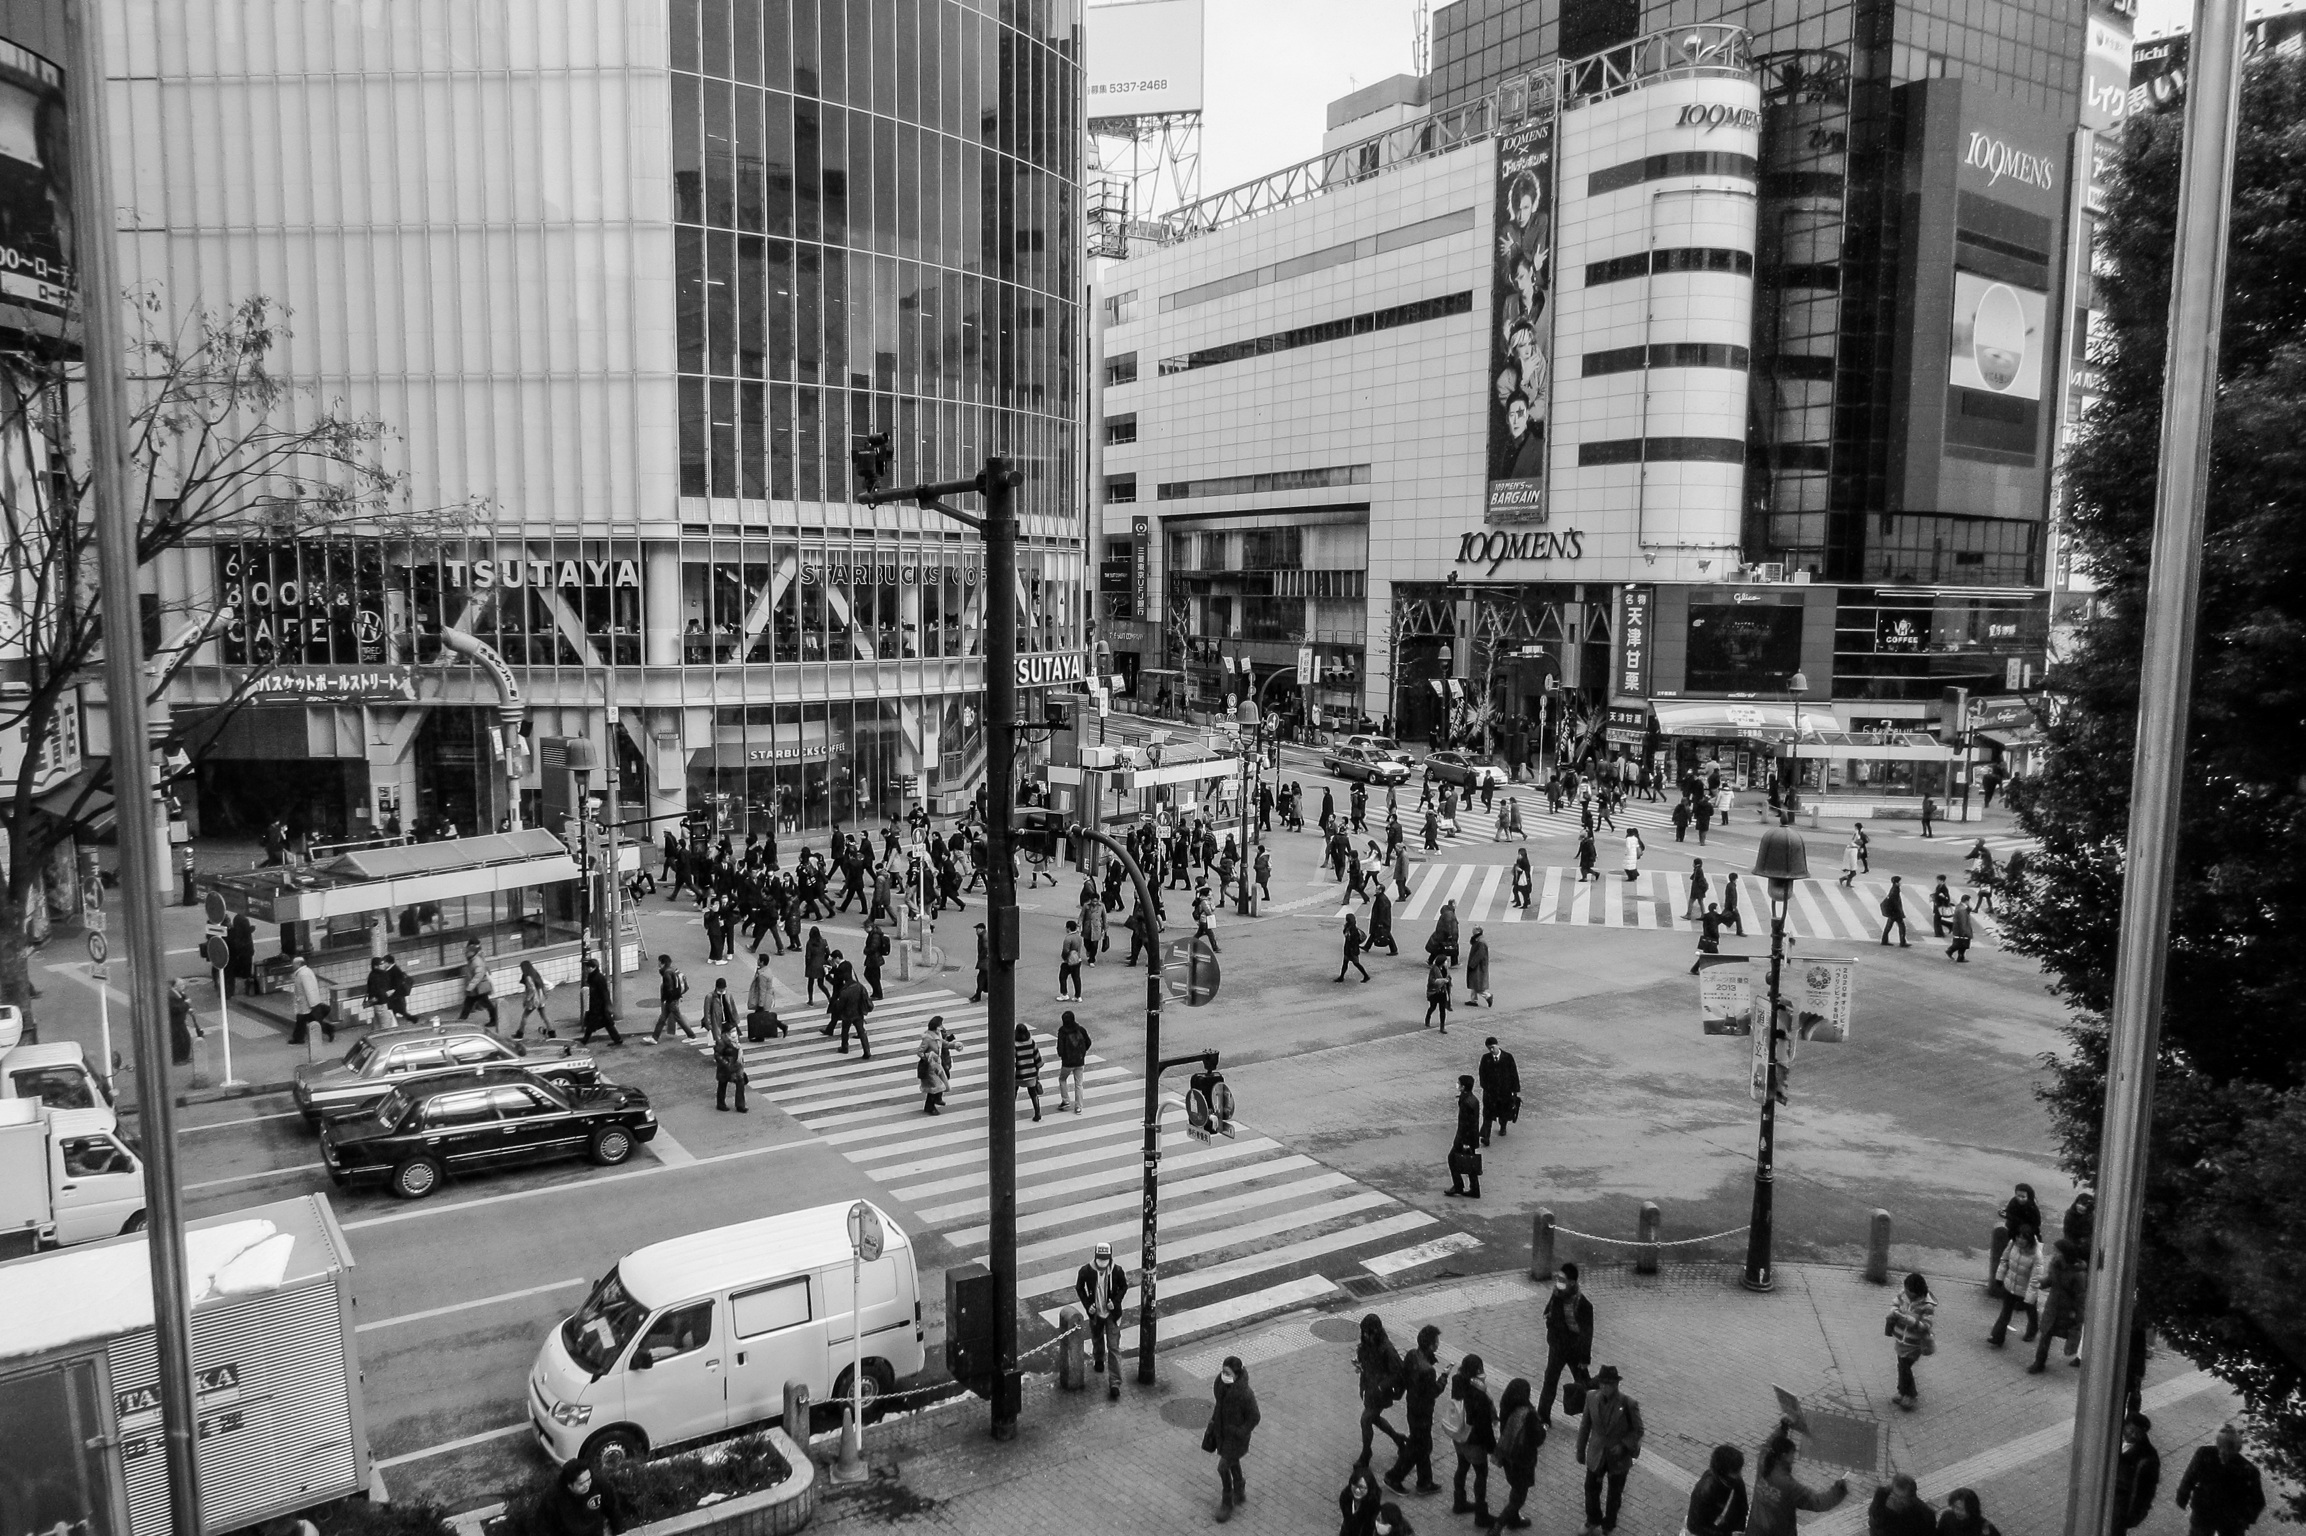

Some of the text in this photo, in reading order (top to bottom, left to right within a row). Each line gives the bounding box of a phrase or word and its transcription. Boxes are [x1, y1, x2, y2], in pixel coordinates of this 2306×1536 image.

[1109, 79, 1168, 93] 5337-2468
[1490, 490, 1541, 506] BARGAIN
[1455, 526, 1584, 577] 109MEN'S
[445, 558, 640, 588] TSUTAYA
[800, 564, 939, 586] STARBUCKS
[1625, 594, 1647, 605] 名物
[227, 618, 328, 643] CAFE
[1624, 607, 1643, 691] 天津甘栗
[1014, 655, 1080, 684] SUTAYA
[256, 673, 398, 692] バスケットボールストリート
[750, 742, 846, 760] STARBUCKS COFFEE
[1715, 983, 1737, 992] 2013
